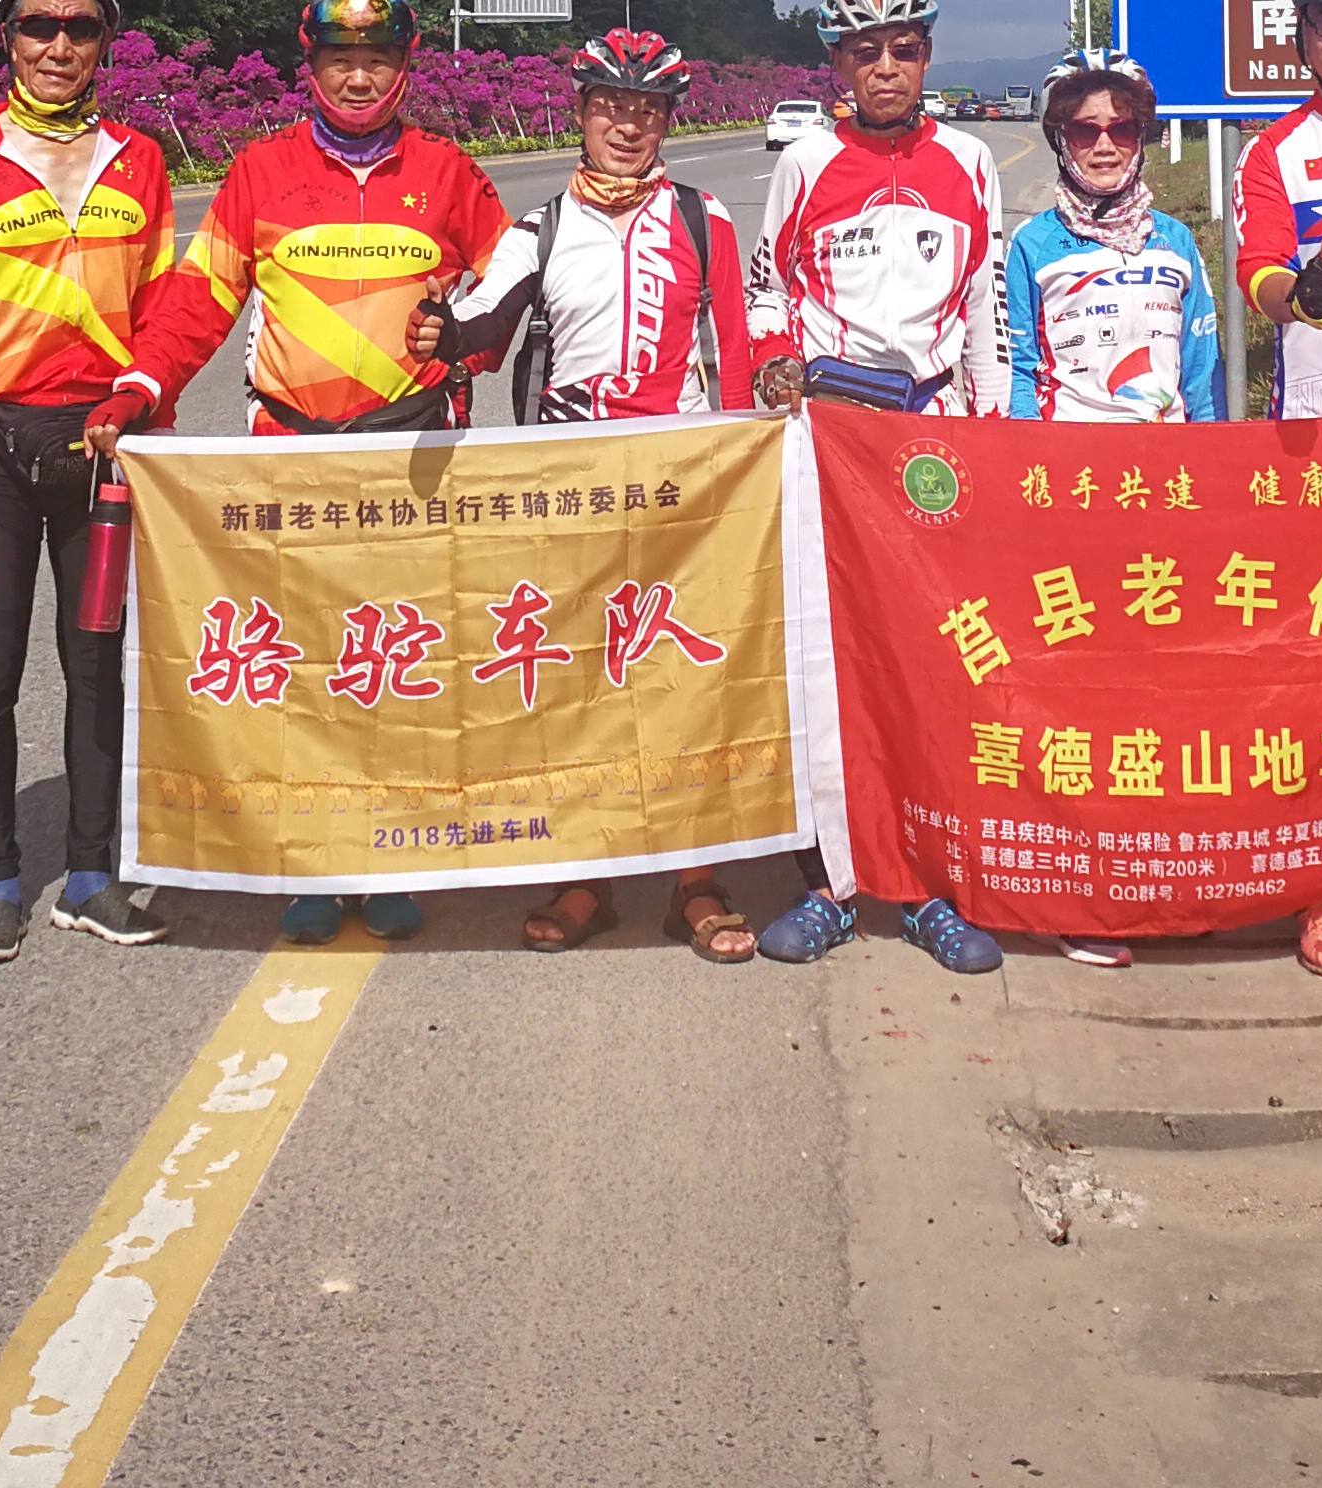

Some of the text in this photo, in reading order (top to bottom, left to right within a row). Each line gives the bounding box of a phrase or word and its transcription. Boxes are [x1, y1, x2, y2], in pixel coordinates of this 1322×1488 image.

[286, 245, 433, 261] XINJIANGQIYOU
[221, 480, 681, 532] 新疆老年体协自行车骑游委员会
[188, 579, 726, 711] 骆驼车队
[373, 816, 553, 849] 2018先进车队
[1098, 831, 1172, 853] 阳光保险
[1178, 828, 1271, 853] 鲁东家具城
[981, 873, 1094, 897] 18363318158
[1195, 878, 1286, 901] 132796462
